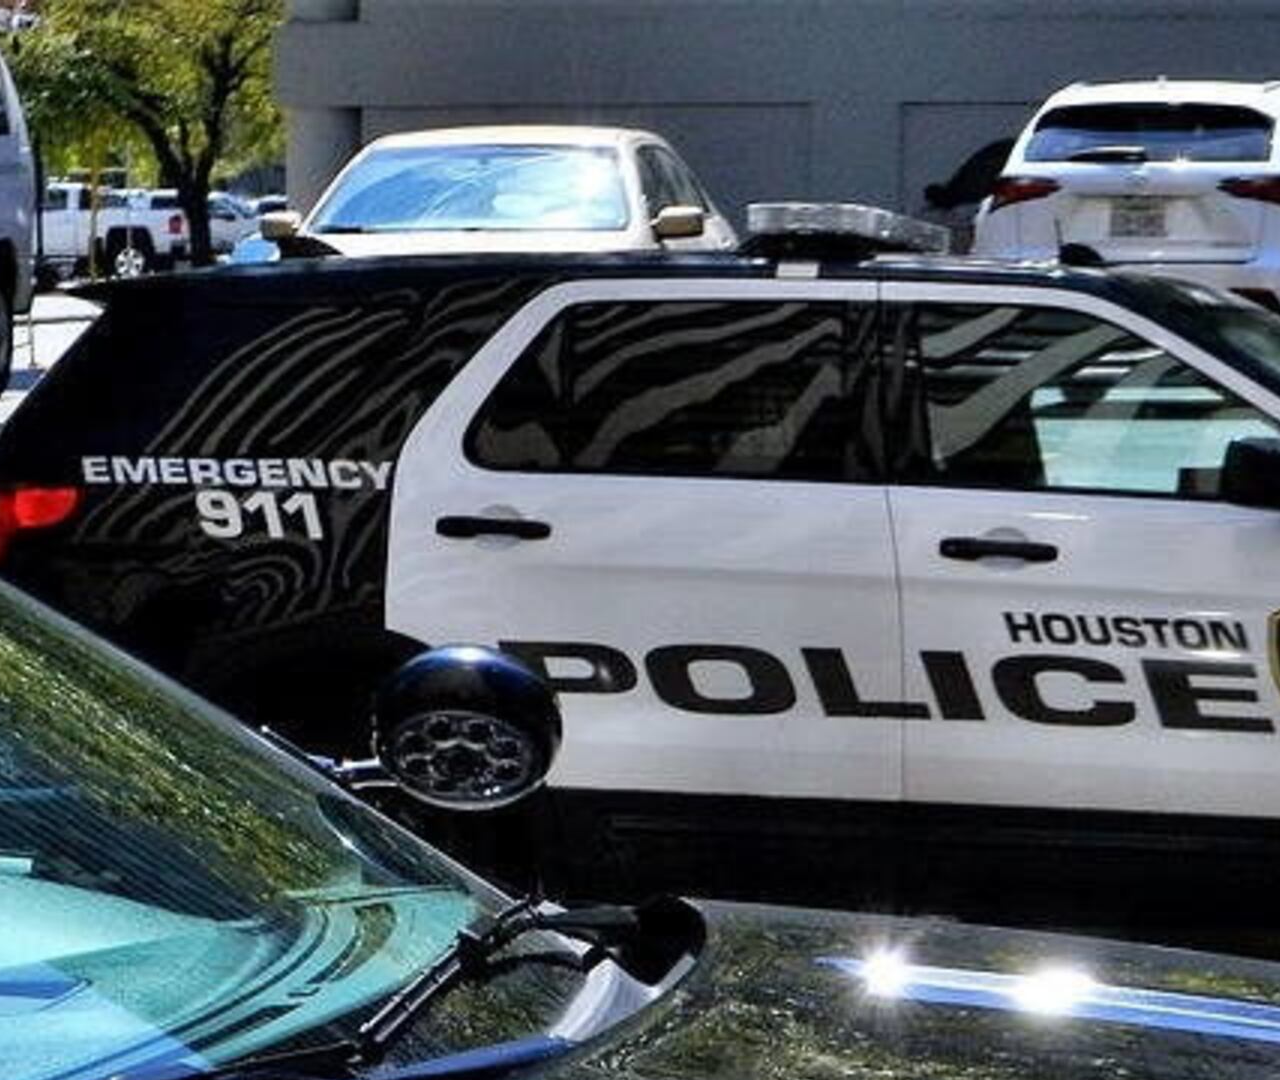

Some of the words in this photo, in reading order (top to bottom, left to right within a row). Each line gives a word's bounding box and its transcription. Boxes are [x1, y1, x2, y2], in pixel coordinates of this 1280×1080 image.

[81, 455, 394, 491] EMERGENCY
[195, 488, 323, 541] 911
[1003, 612, 1250, 651] HOUSTON
[498, 640, 1276, 734] POLICE
